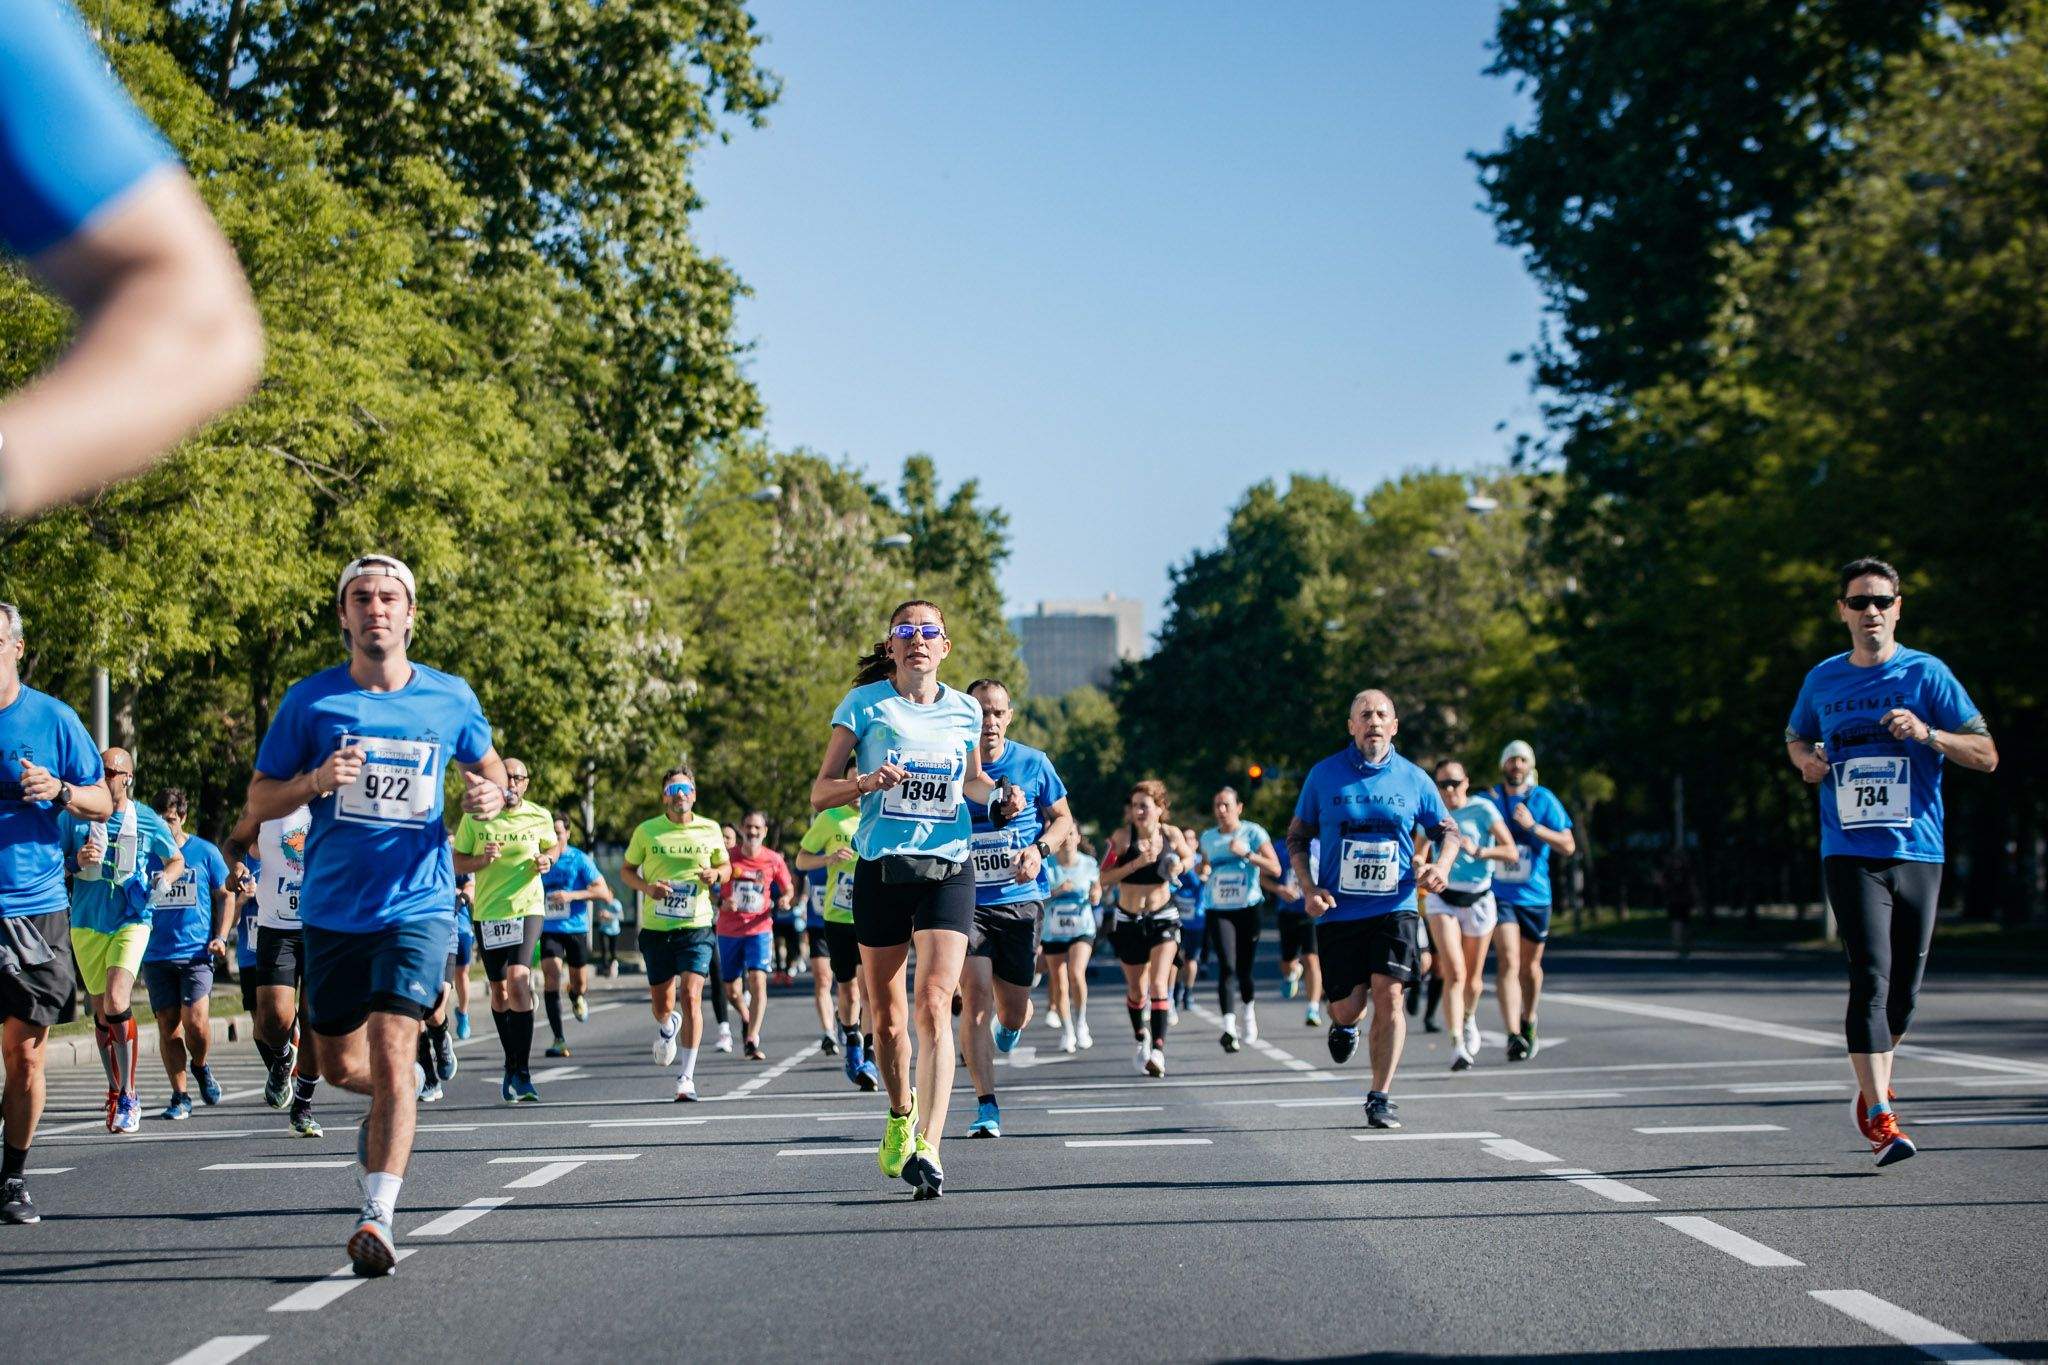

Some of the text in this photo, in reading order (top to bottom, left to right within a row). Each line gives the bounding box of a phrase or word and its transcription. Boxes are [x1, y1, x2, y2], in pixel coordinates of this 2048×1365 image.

[1824, 694, 1905, 716] DECIMAS
[914, 761, 951, 770] BOMBEROS
[365, 775, 410, 802] 922
[901, 780, 947, 802] 1394
[1854, 786, 1889, 807] 734
[478, 832, 535, 842] DECIMAS
[652, 845, 709, 855] DECIMAS
[973, 853, 1010, 871] 1506
[1354, 864, 1387, 880] 1873
[289, 896, 302, 910] 9
[664, 895, 688, 909] 1225
[493, 923, 511, 937] 872
